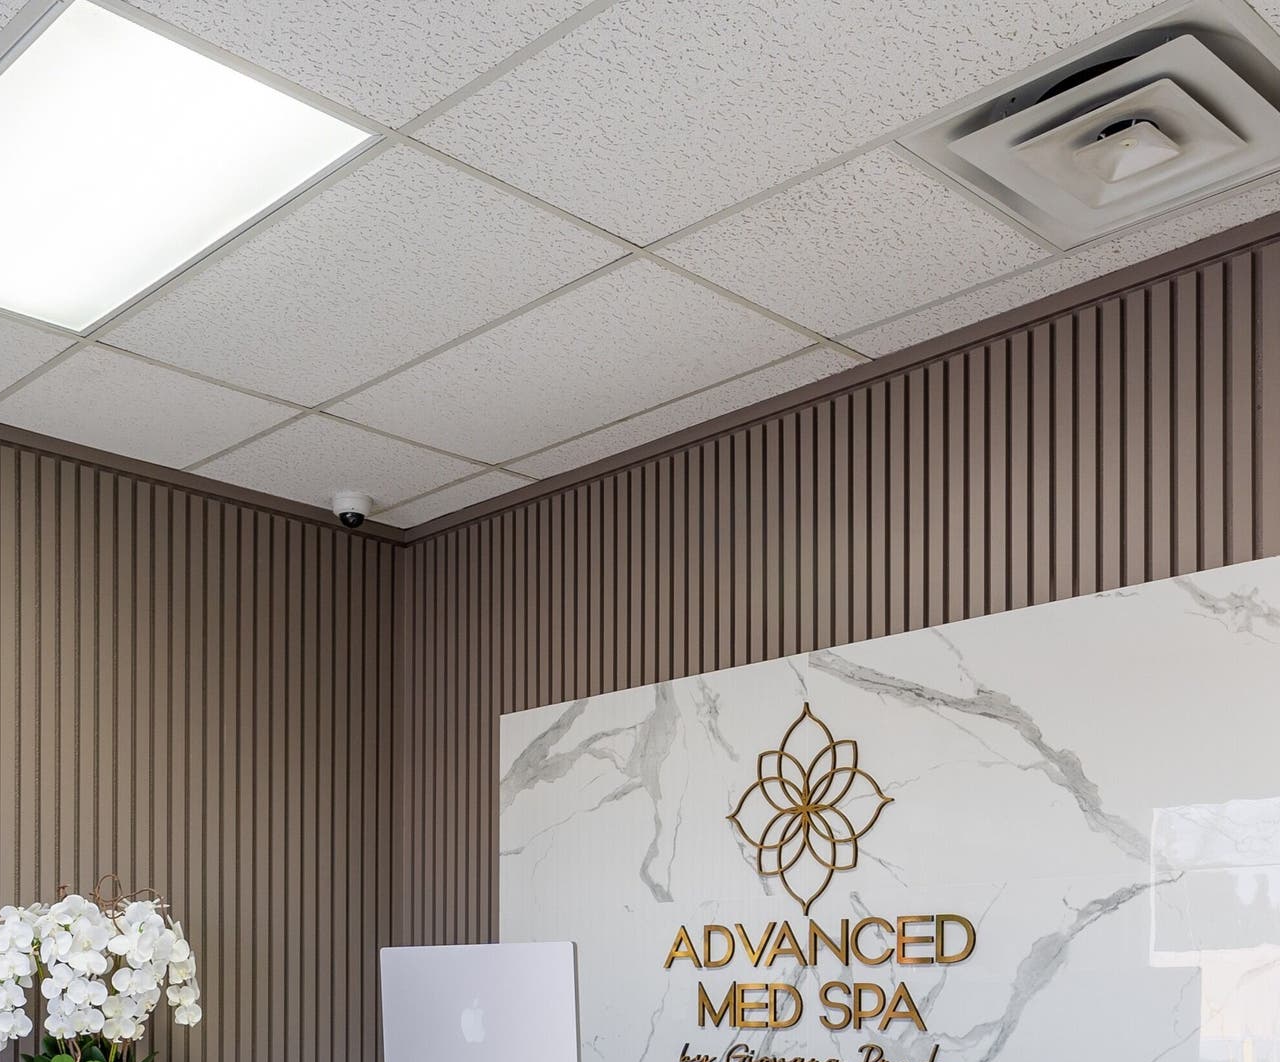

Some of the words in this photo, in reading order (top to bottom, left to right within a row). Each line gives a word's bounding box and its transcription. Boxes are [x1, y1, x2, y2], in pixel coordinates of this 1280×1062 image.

[663, 913, 976, 969] ADVANCED
[697, 980, 803, 1028] MED
[819, 980, 928, 1032] SPA
